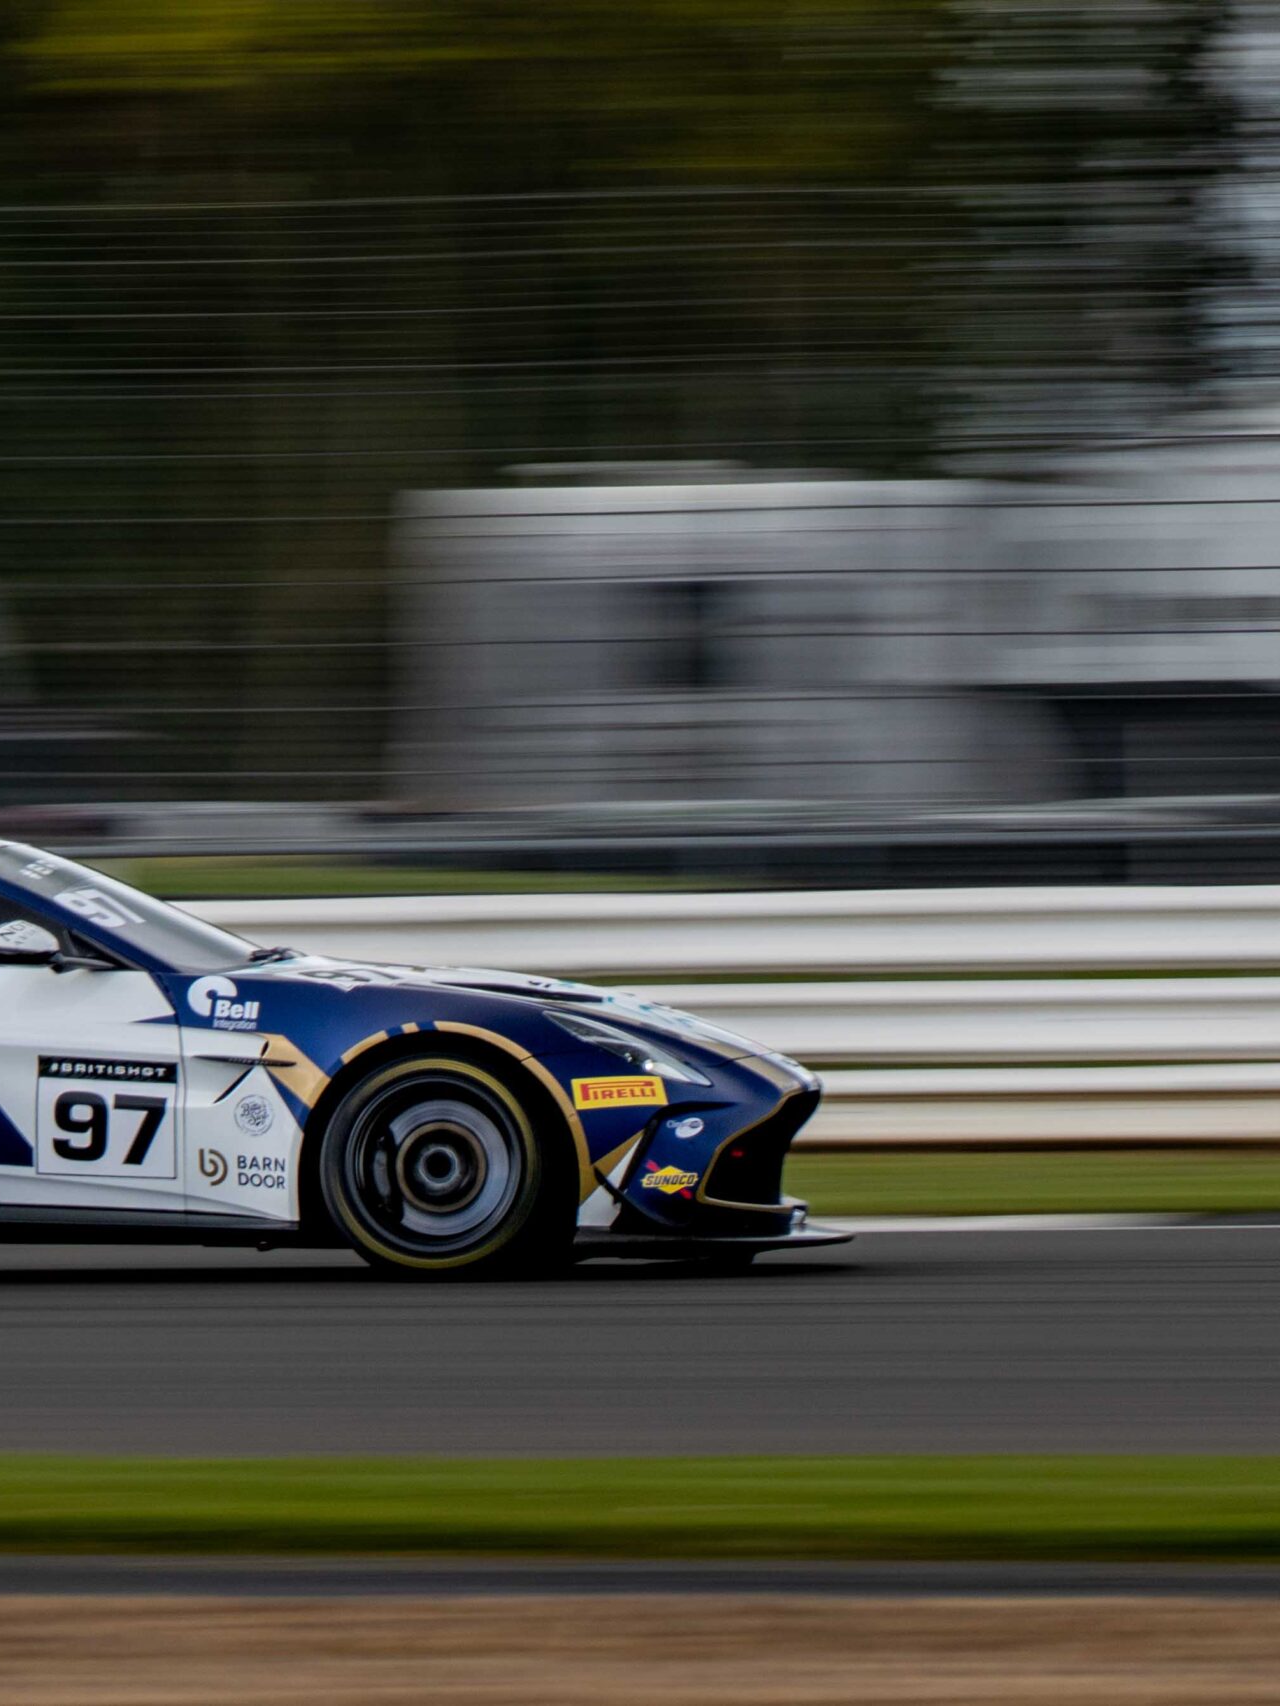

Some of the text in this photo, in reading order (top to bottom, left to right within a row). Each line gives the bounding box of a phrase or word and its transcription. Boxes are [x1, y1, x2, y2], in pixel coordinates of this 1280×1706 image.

[215, 1001, 261, 1020] Bell
[48, 1062, 167, 1078] #BRITISHGT
[580, 1081, 656, 1101] PIRELLI
[52, 1090, 168, 1166] 97
[237, 1155, 286, 1172] BARN
[237, 1172, 286, 1190] DOOR
[645, 1174, 696, 1186] SUNOCO
